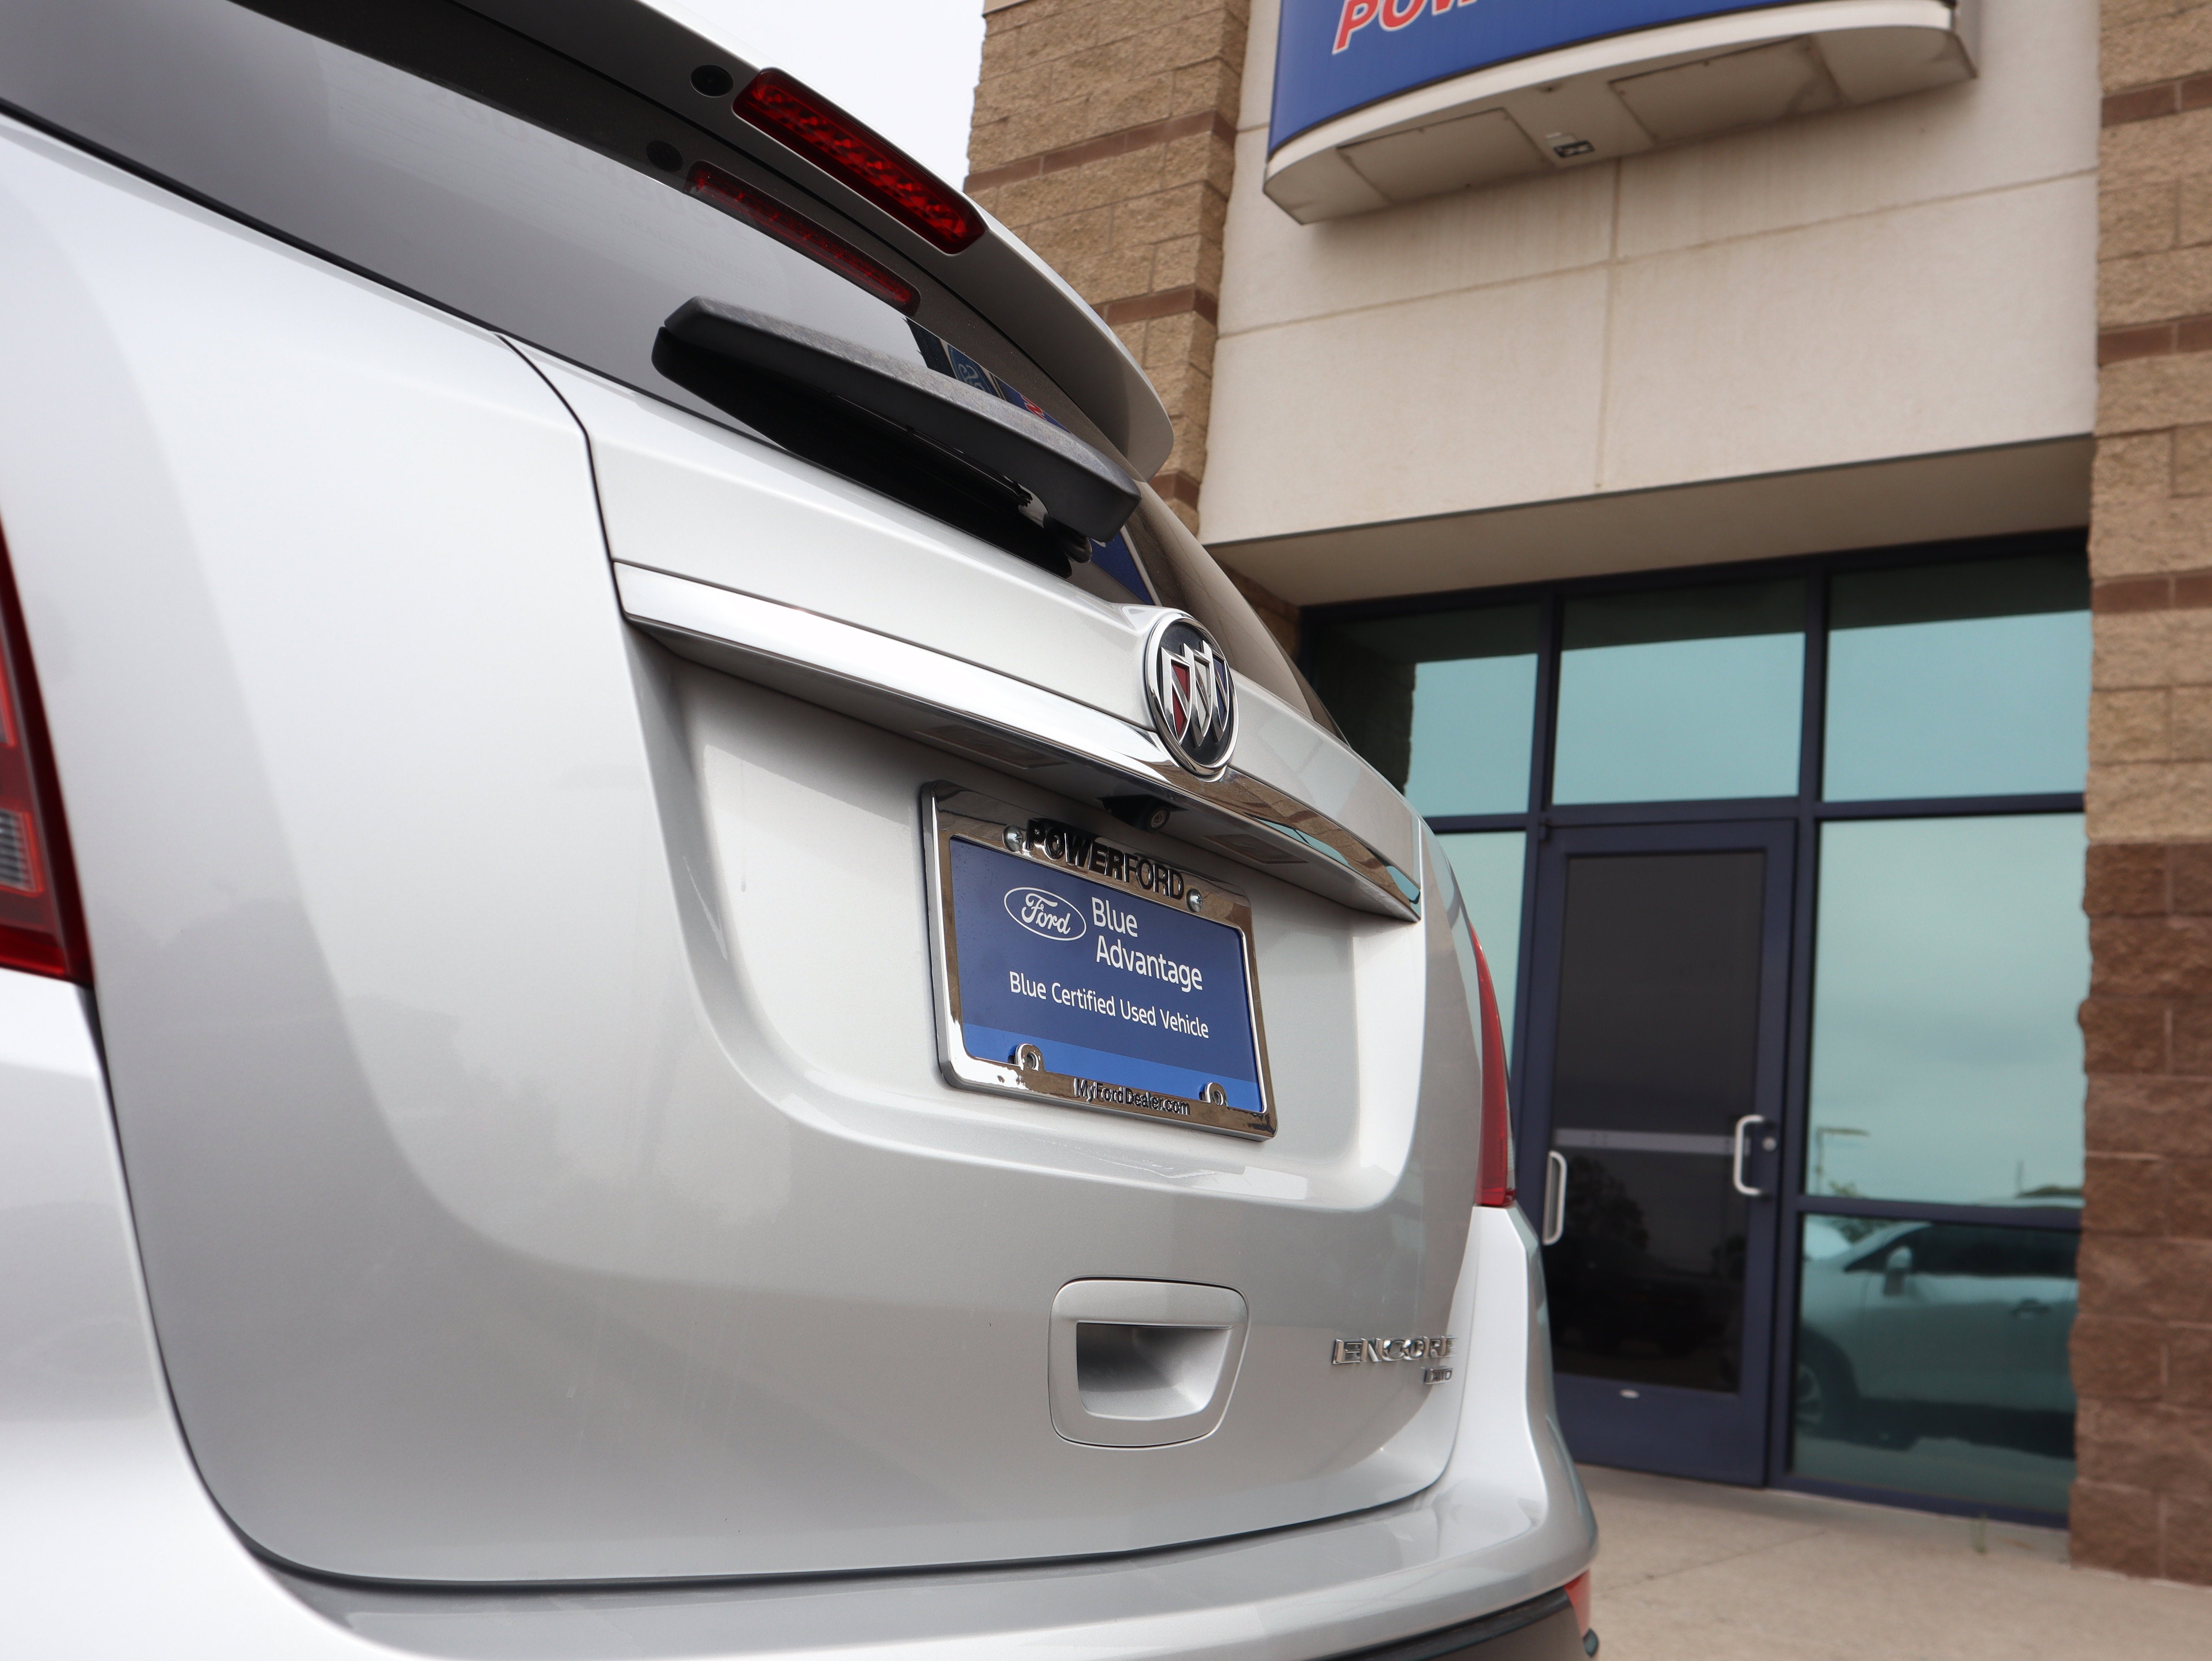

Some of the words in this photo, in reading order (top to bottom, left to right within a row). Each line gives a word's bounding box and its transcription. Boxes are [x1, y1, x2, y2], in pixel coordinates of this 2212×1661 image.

[1331, 0, 1478, 55] PO
[1021, 893, 1071, 935] Ford
[1091, 897, 1138, 938] Blue
[1096, 935, 1203, 993] Advantage
[1009, 971, 1047, 1000] Blue
[1052, 982, 1116, 1017] Certified
[1120, 999, 1157, 1026] Used
[1160, 1009, 1209, 1039] Vehicle
[1073, 1078, 1190, 1116] MyFordDealer.com
[1333, 1335, 1458, 1365] ENCORE
